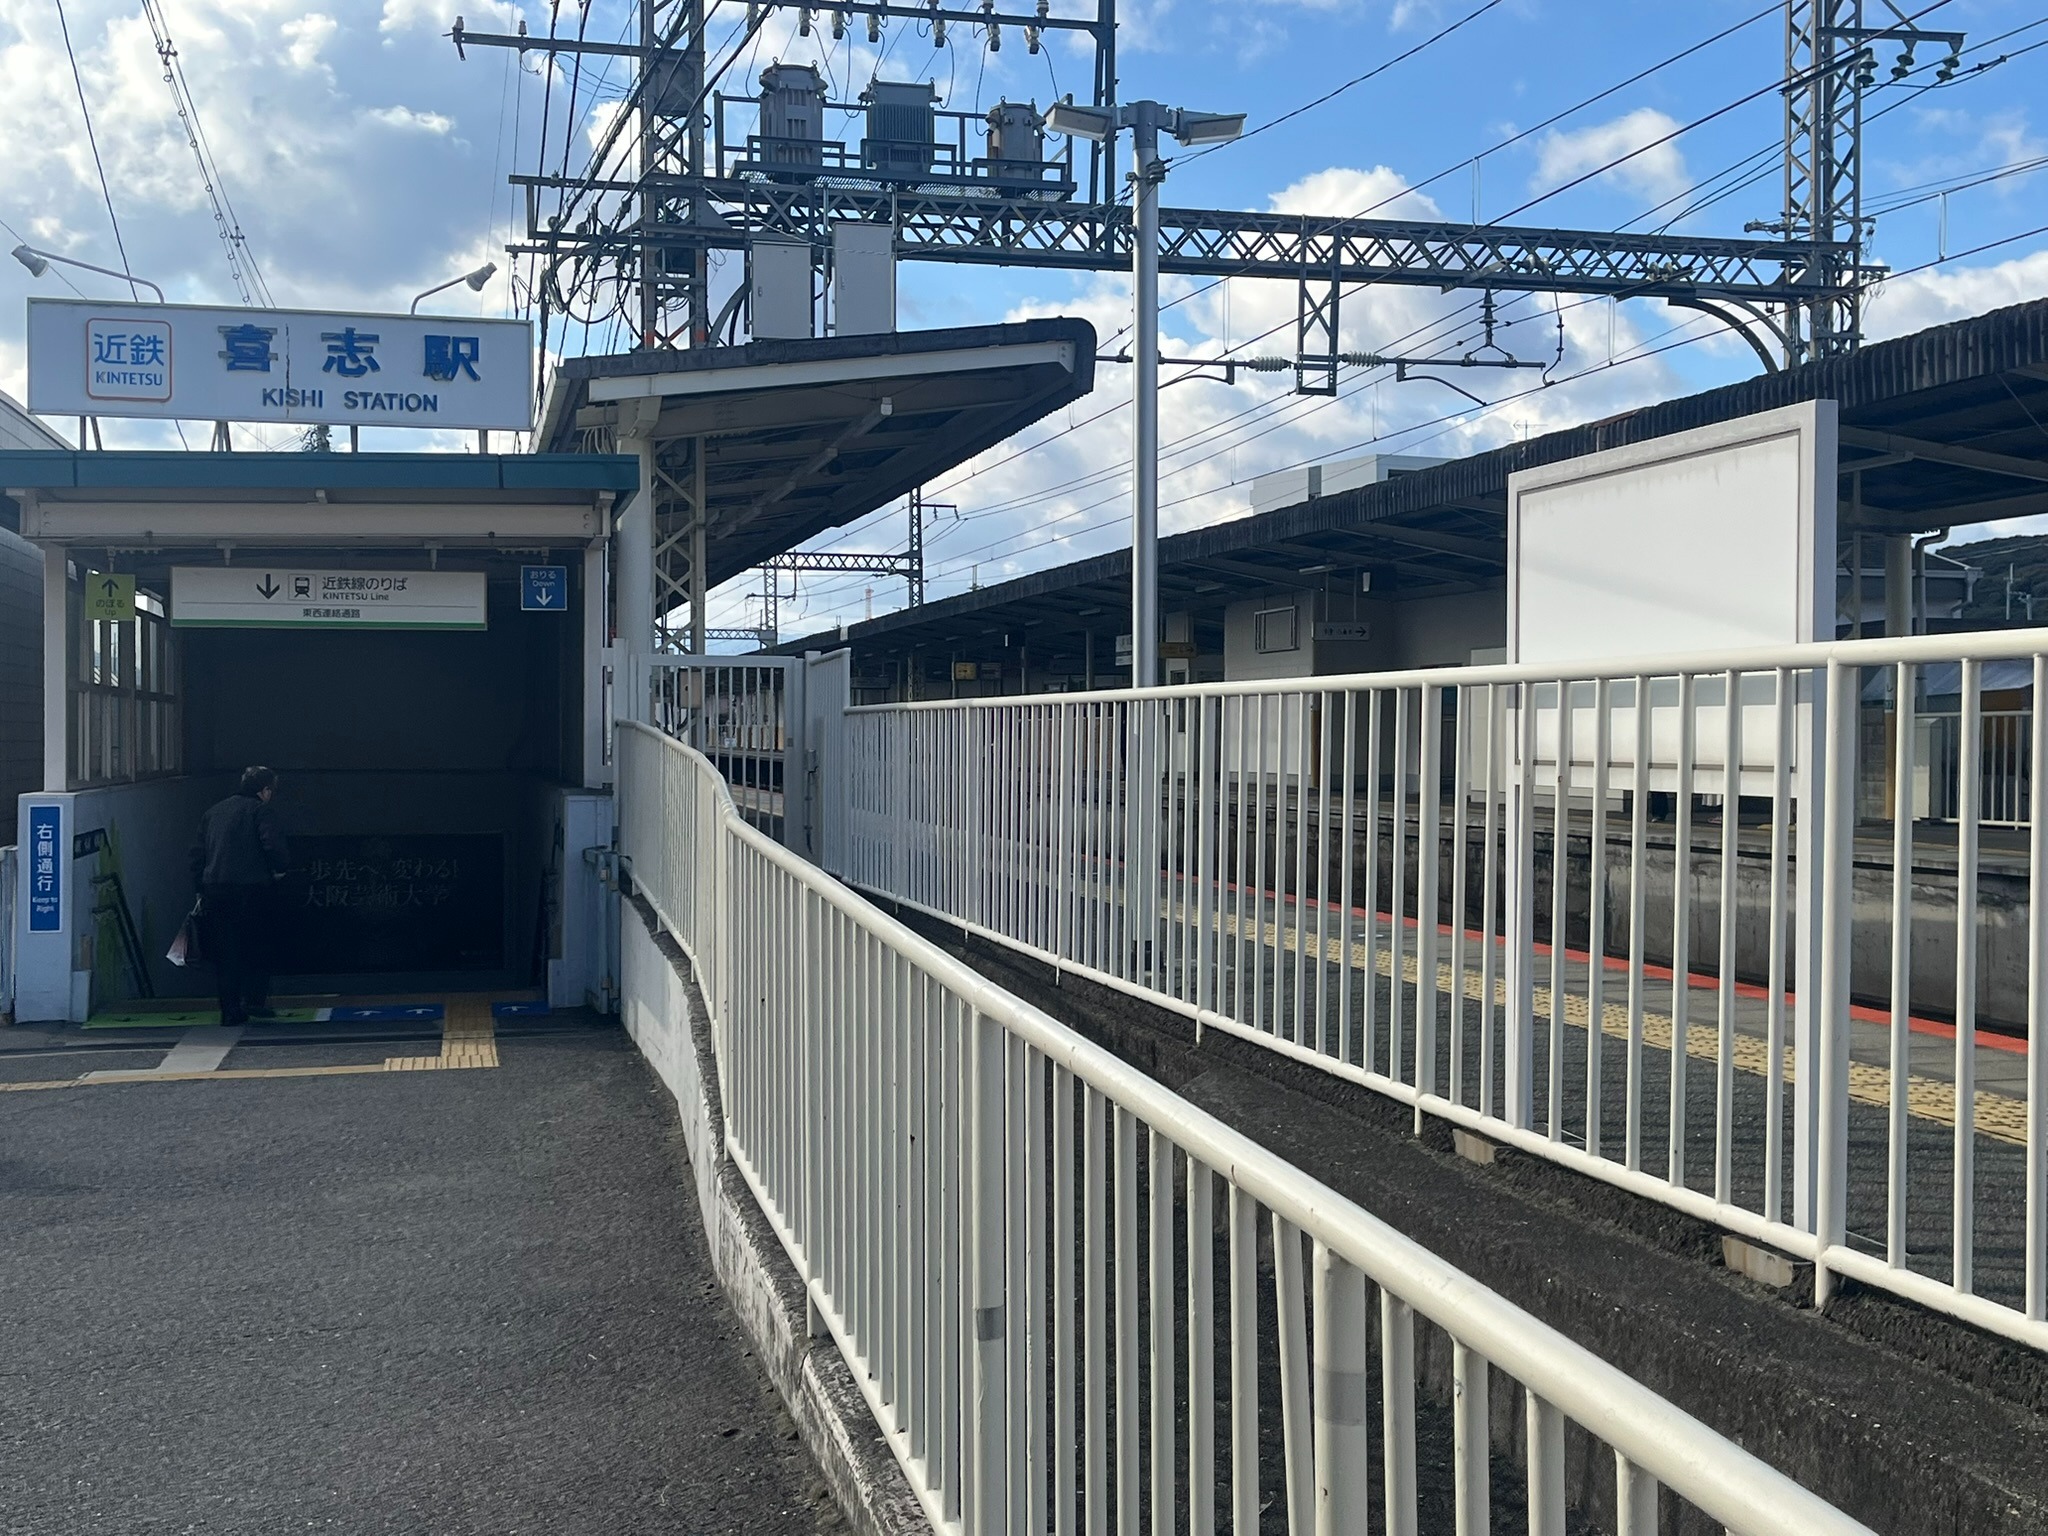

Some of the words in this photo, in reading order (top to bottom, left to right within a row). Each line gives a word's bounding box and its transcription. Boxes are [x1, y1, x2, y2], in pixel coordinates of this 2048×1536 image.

[94, 333, 165, 366] 近鉄
[217, 323, 481, 381] 喜志駅
[96, 371, 163, 386] KINTETSU
[262, 388, 323, 408] KISHI
[343, 391, 438, 412] STATION
[530, 570, 557, 579] おりる
[322, 576, 408, 591] 近鉄線のりば
[95, 599, 125, 608] のぼる
[322, 592, 368, 600] KINTETSU
[370, 593, 389, 601] Line
[105, 609, 117, 617] Up
[303, 608, 360, 618] 東西連絡通路
[36, 823, 53, 891] 右側通行
